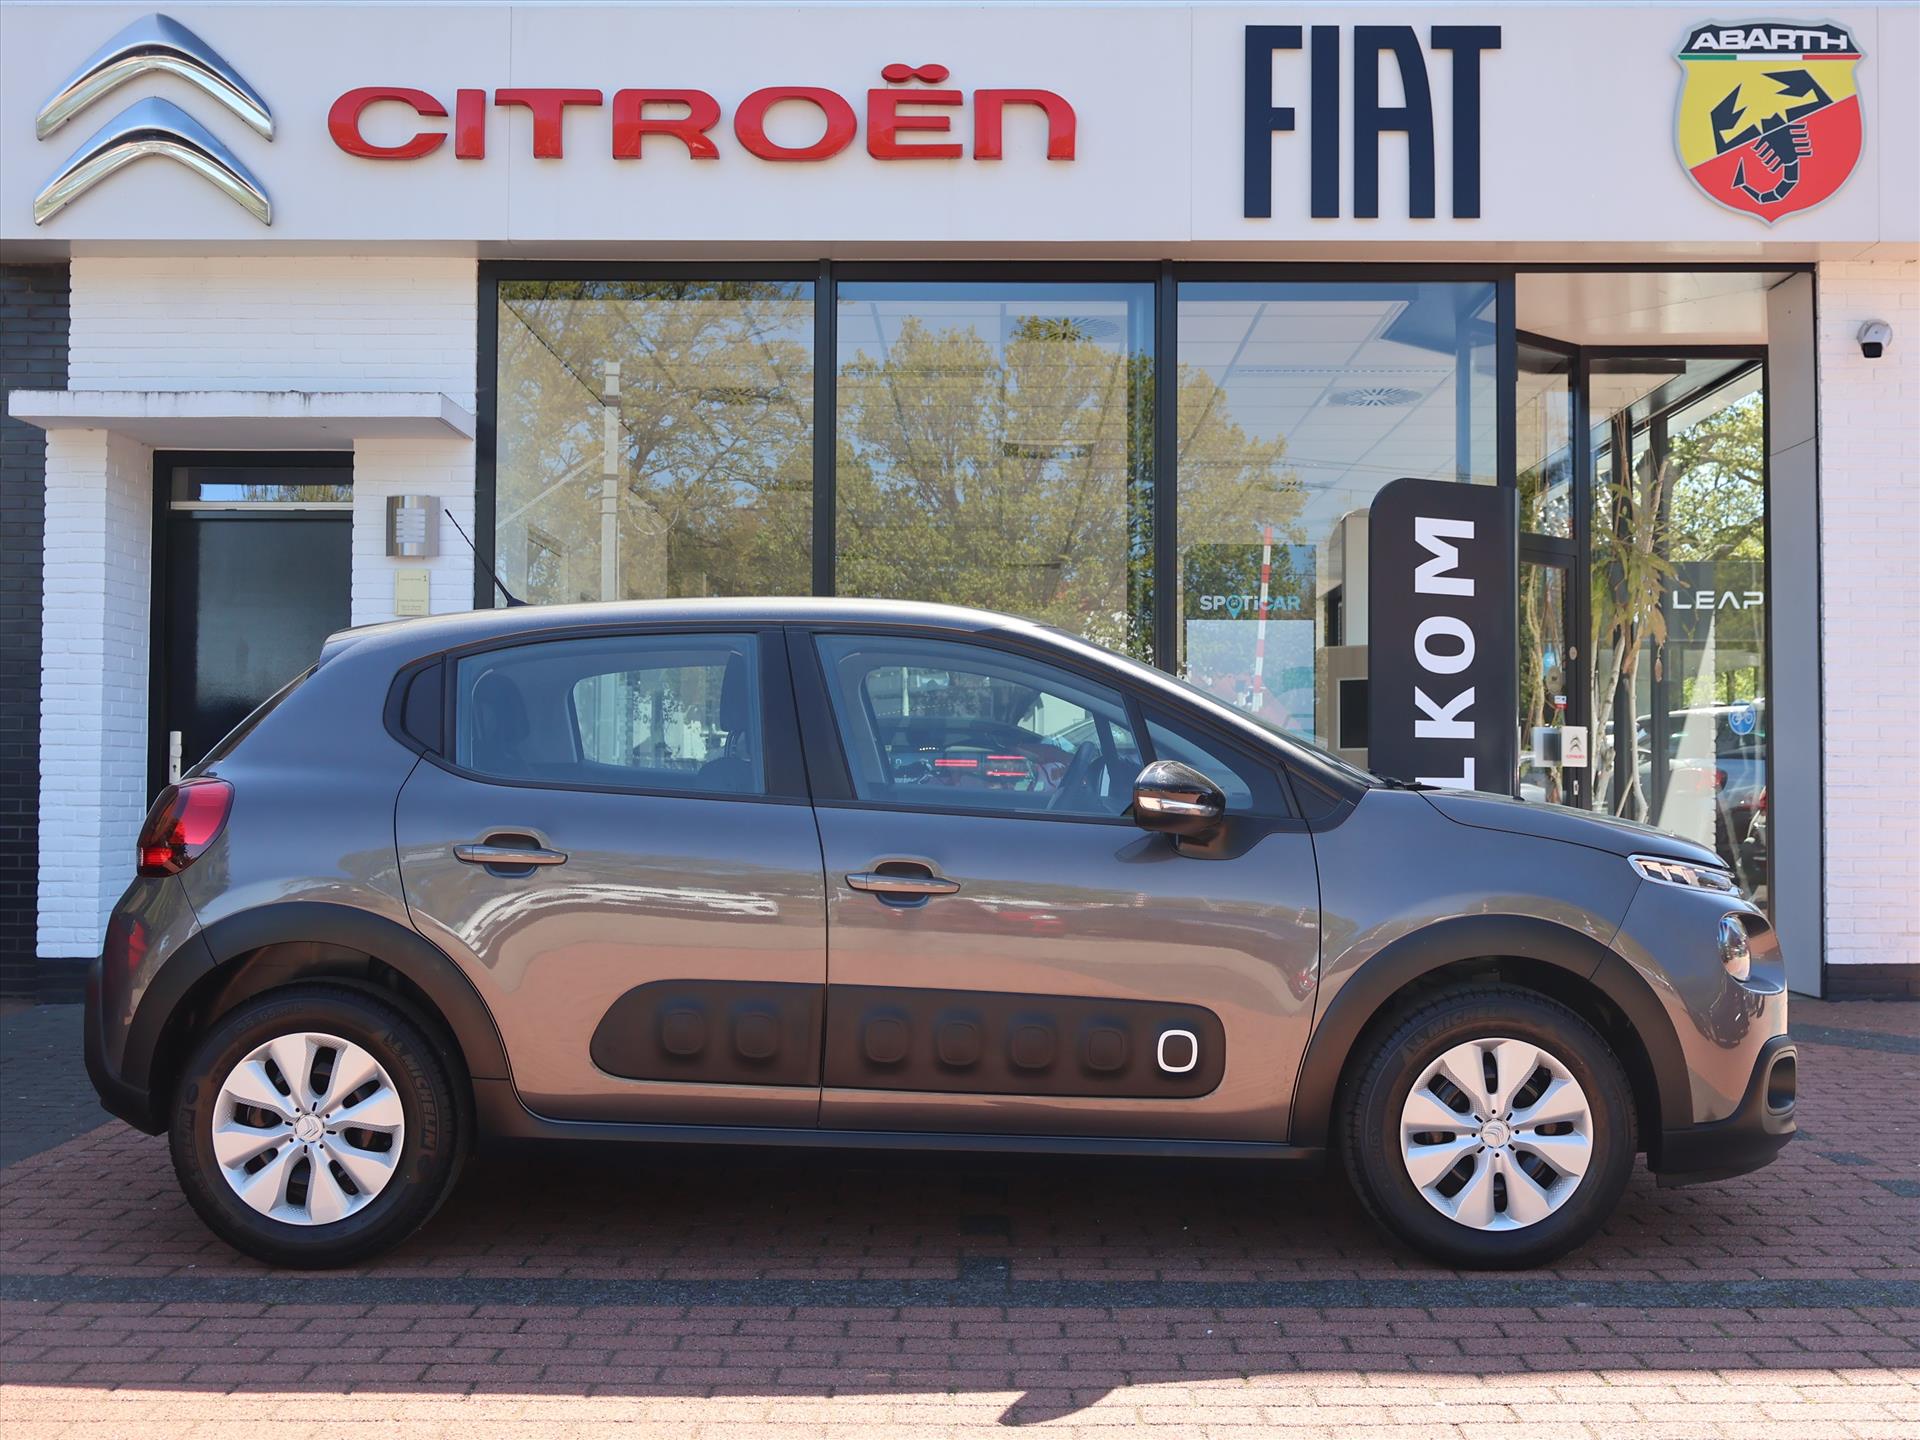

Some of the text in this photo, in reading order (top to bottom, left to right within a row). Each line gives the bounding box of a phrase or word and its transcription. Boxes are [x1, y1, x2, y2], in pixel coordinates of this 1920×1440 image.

[1691, 28, 1848, 50] ABARTH
[328, 64, 1076, 161] CITROËN
[1244, 25, 1501, 218] FIAT
[1672, 590, 1764, 610] LEAP
[1414, 516, 1475, 791] LKOM
